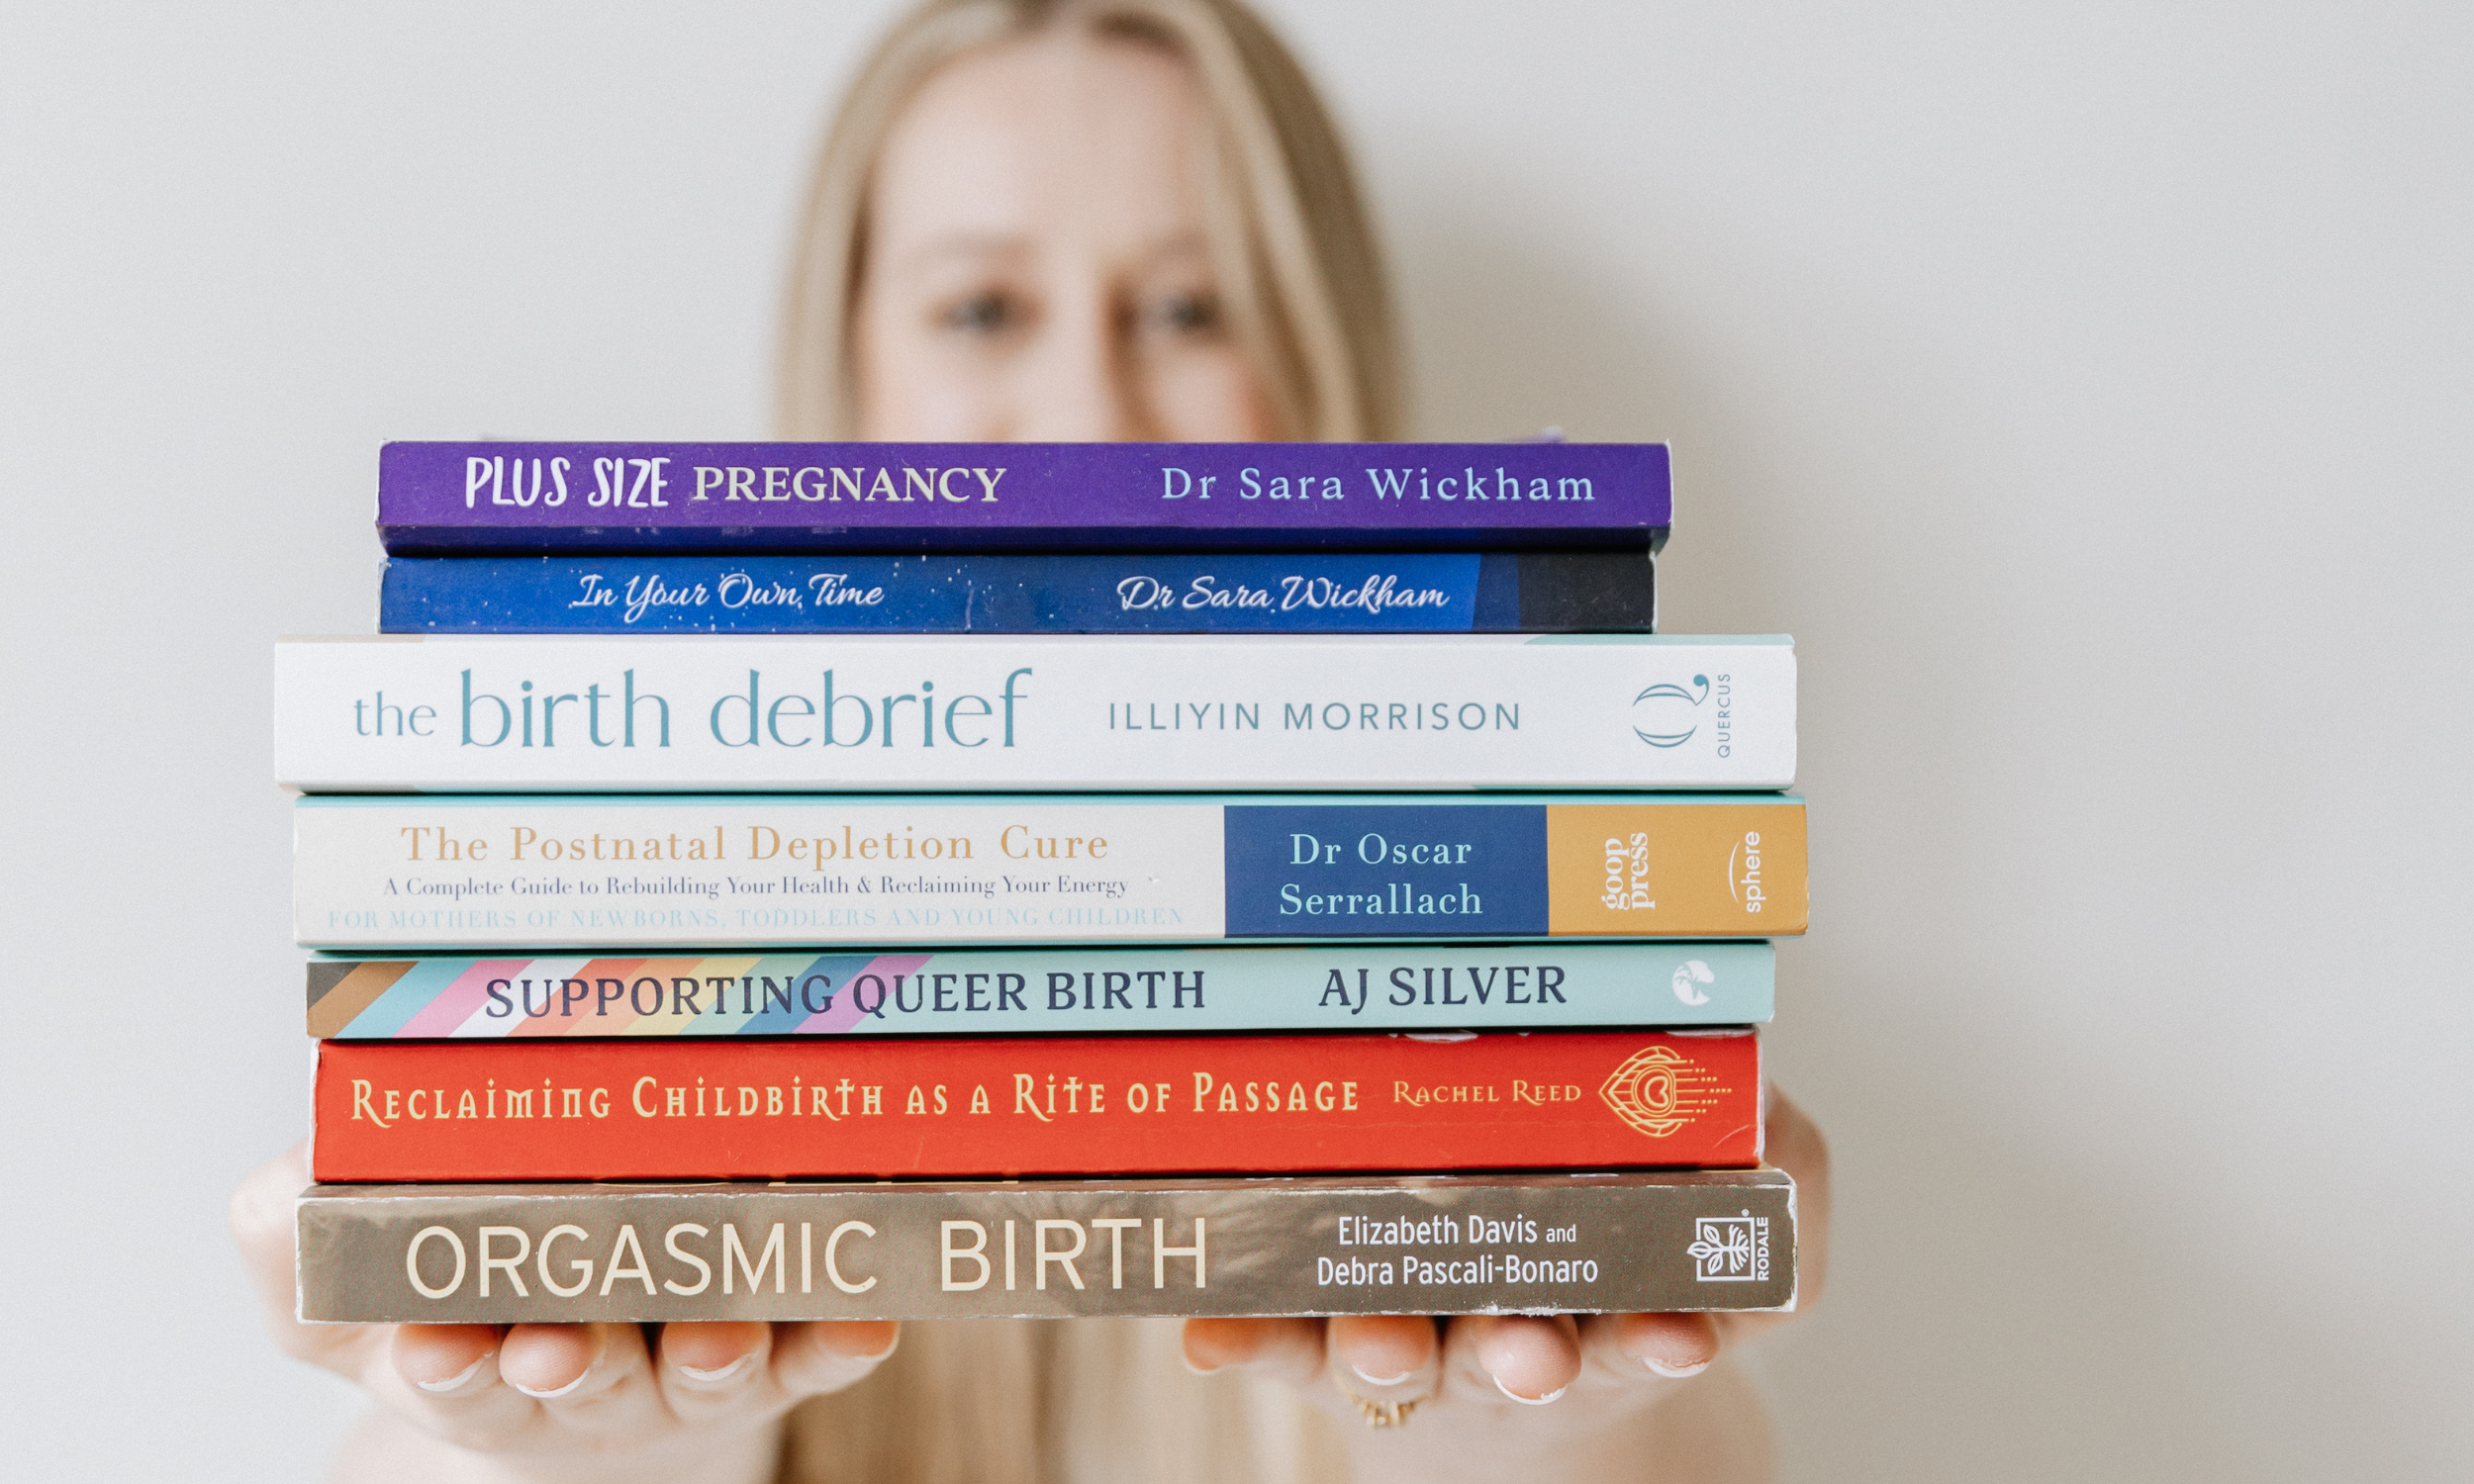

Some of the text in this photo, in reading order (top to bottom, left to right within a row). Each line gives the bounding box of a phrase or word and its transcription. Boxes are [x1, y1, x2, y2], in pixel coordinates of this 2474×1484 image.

[466, 456, 1006, 509] PLUS SIZE PREGNANCY
[1163, 467, 1594, 501] Dr Sara Wickham
[571, 574, 883, 623] In Your Own Time
[1117, 575, 1449, 613] Dr Sara Wickham
[355, 668, 1032, 747] the birth debrief
[1110, 702, 1518, 730] ILLIYIN MORRISON
[1717, 674, 1731, 758] QUERCUS
[400, 825, 1108, 871] The Postnatal Depletion Cure
[1290, 833, 1472, 864] Dr Oscar
[1630, 832, 1657, 910] press
[384, 876, 1128, 900] A Complete Guide to Rebuilding Your Health & Reclaiming Your Energy
[1601, 837, 1631, 911] goop
[1740, 830, 1766, 914] sphere
[329, 908, 1182, 929] FOR MOTHERS OF NEWBORNS, TODDLERS AND YOUNG CHILDREN
[1281, 883, 1481, 915] Serrallach
[487, 971, 1204, 1017] SUPPORTING QUEER BIRTH
[1319, 967, 1566, 1015] AJ SILVER
[1339, 1213, 1576, 1245] Elizabeth Davis and
[1756, 1216, 1770, 1282] RODALE
[407, 1216, 1205, 1299] ORGASMIC BIRTH
[1318, 1254, 1598, 1285] Debra Pascali-Bonaro
